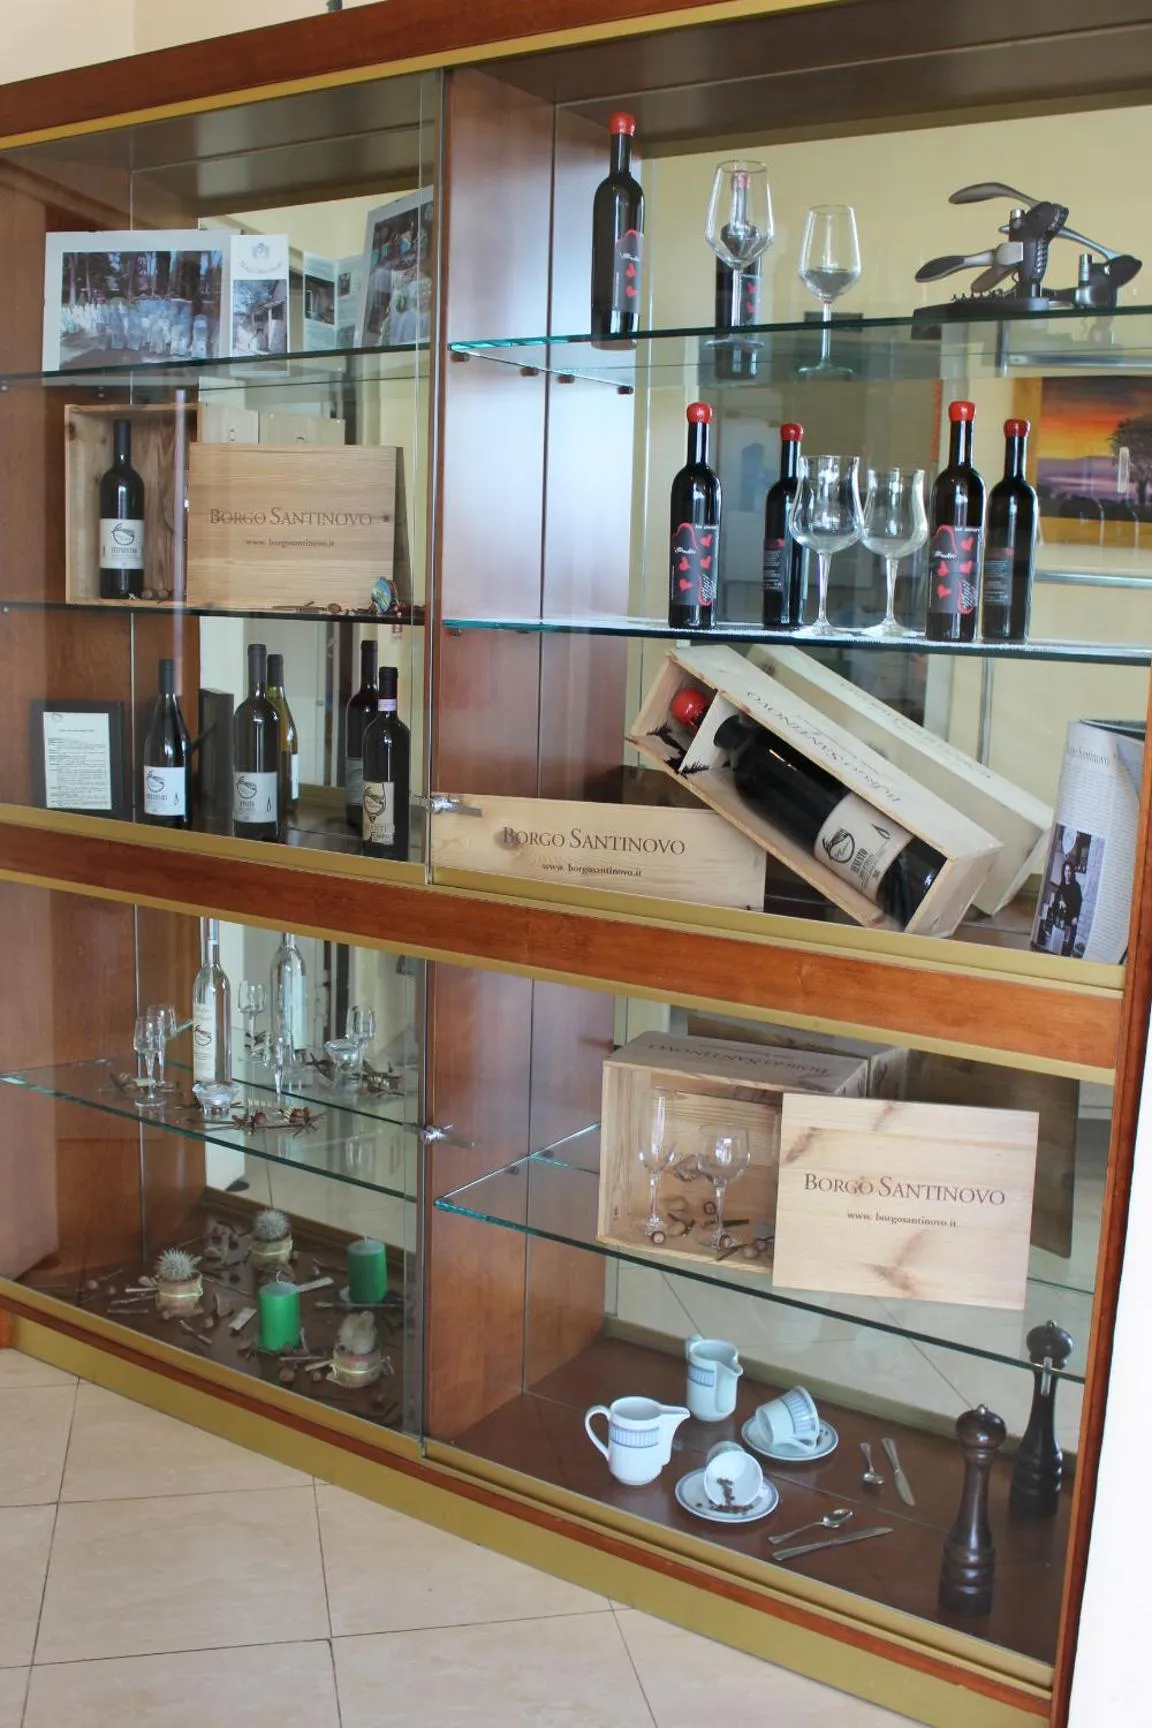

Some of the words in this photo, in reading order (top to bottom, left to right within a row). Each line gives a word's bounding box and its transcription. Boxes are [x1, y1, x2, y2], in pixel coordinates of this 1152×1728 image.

[209, 507, 266, 525] BORGO
[270, 506, 373, 527] SANTINOVO
[502, 826, 566, 848] BORGO
[569, 827, 687, 856] SANTINOVO
[567, 862, 643, 878] borgosantinovo.it
[803, 1172, 874, 1196] BORGO
[878, 1175, 1006, 1206] SANTINOVO
[874, 1211, 957, 1229] borgosantinovo.it
